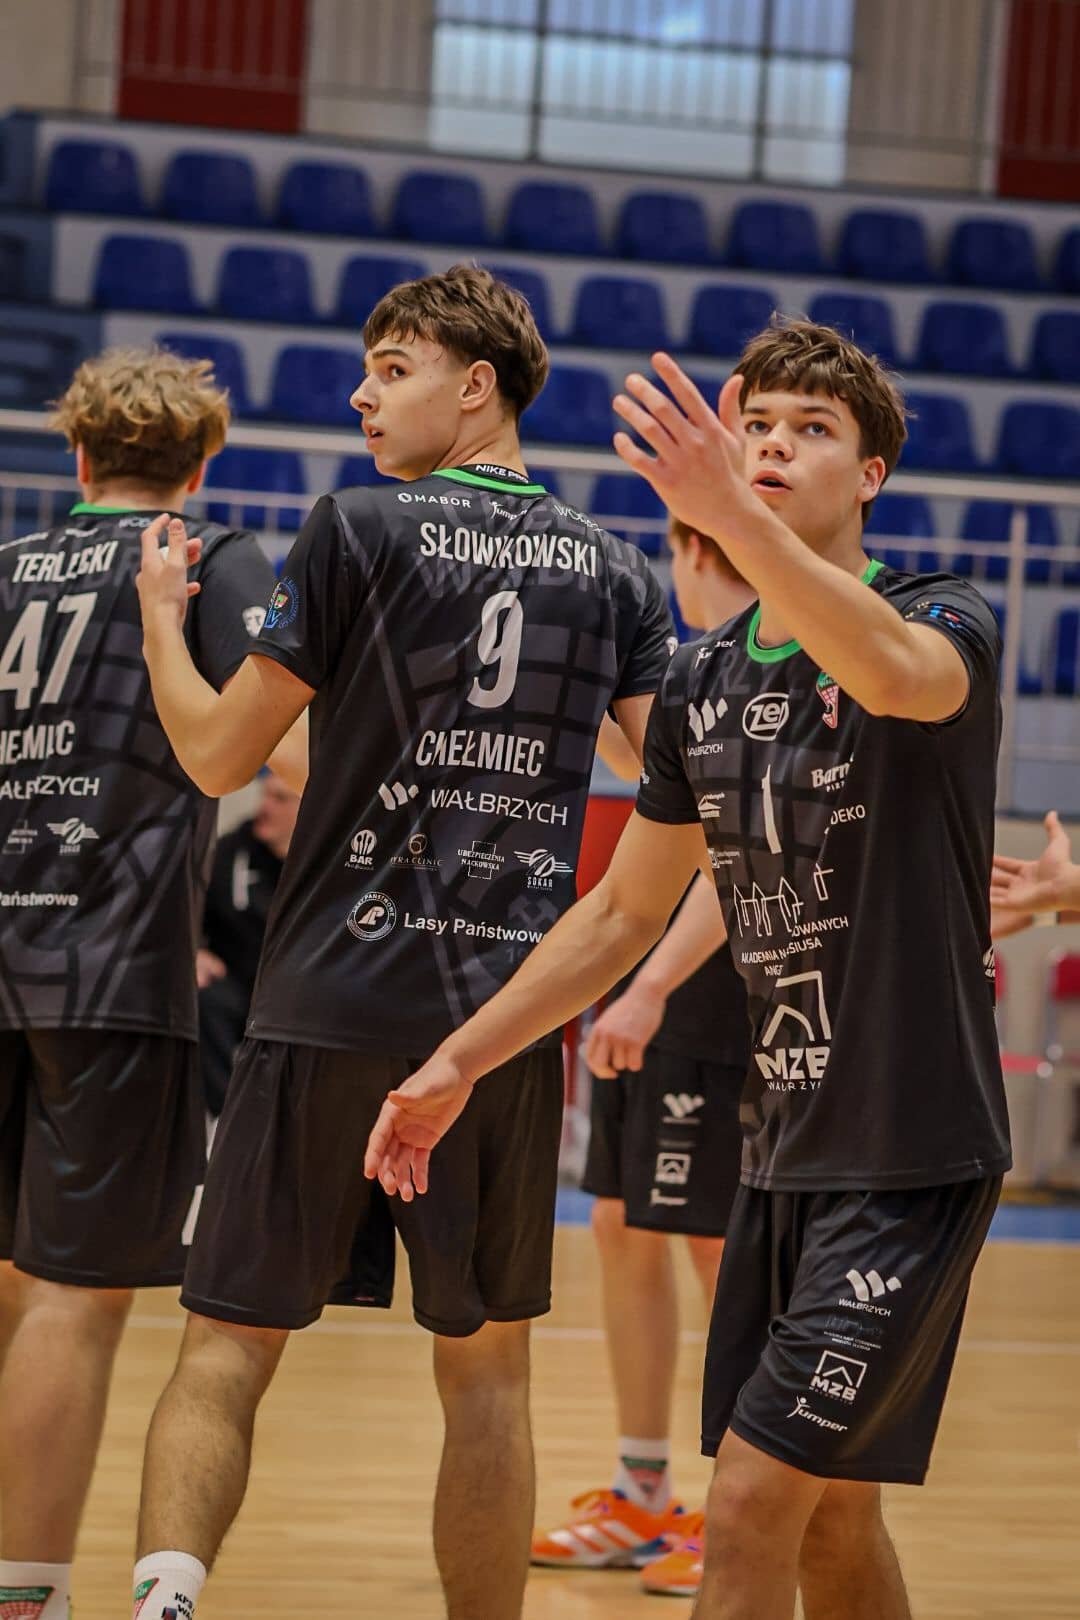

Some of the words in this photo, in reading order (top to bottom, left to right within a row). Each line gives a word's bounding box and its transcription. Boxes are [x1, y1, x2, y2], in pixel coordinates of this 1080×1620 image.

[475, 465, 506, 477] NIKE
[414, 495, 472, 509] MABOR
[0, 592, 98, 711] 47
[467, 590, 524, 708] 9
[431, 789, 569, 826] WAŁBRZYCH
[761, 764, 783, 854] 1
[350, 854, 373, 865] BAR
[403, 912, 448, 935] Lasy
[453, 917, 546, 943] Państwow
[838, 1297, 892, 1317] WAŁBRZYCH
[810, 1375, 857, 1401] MZB
